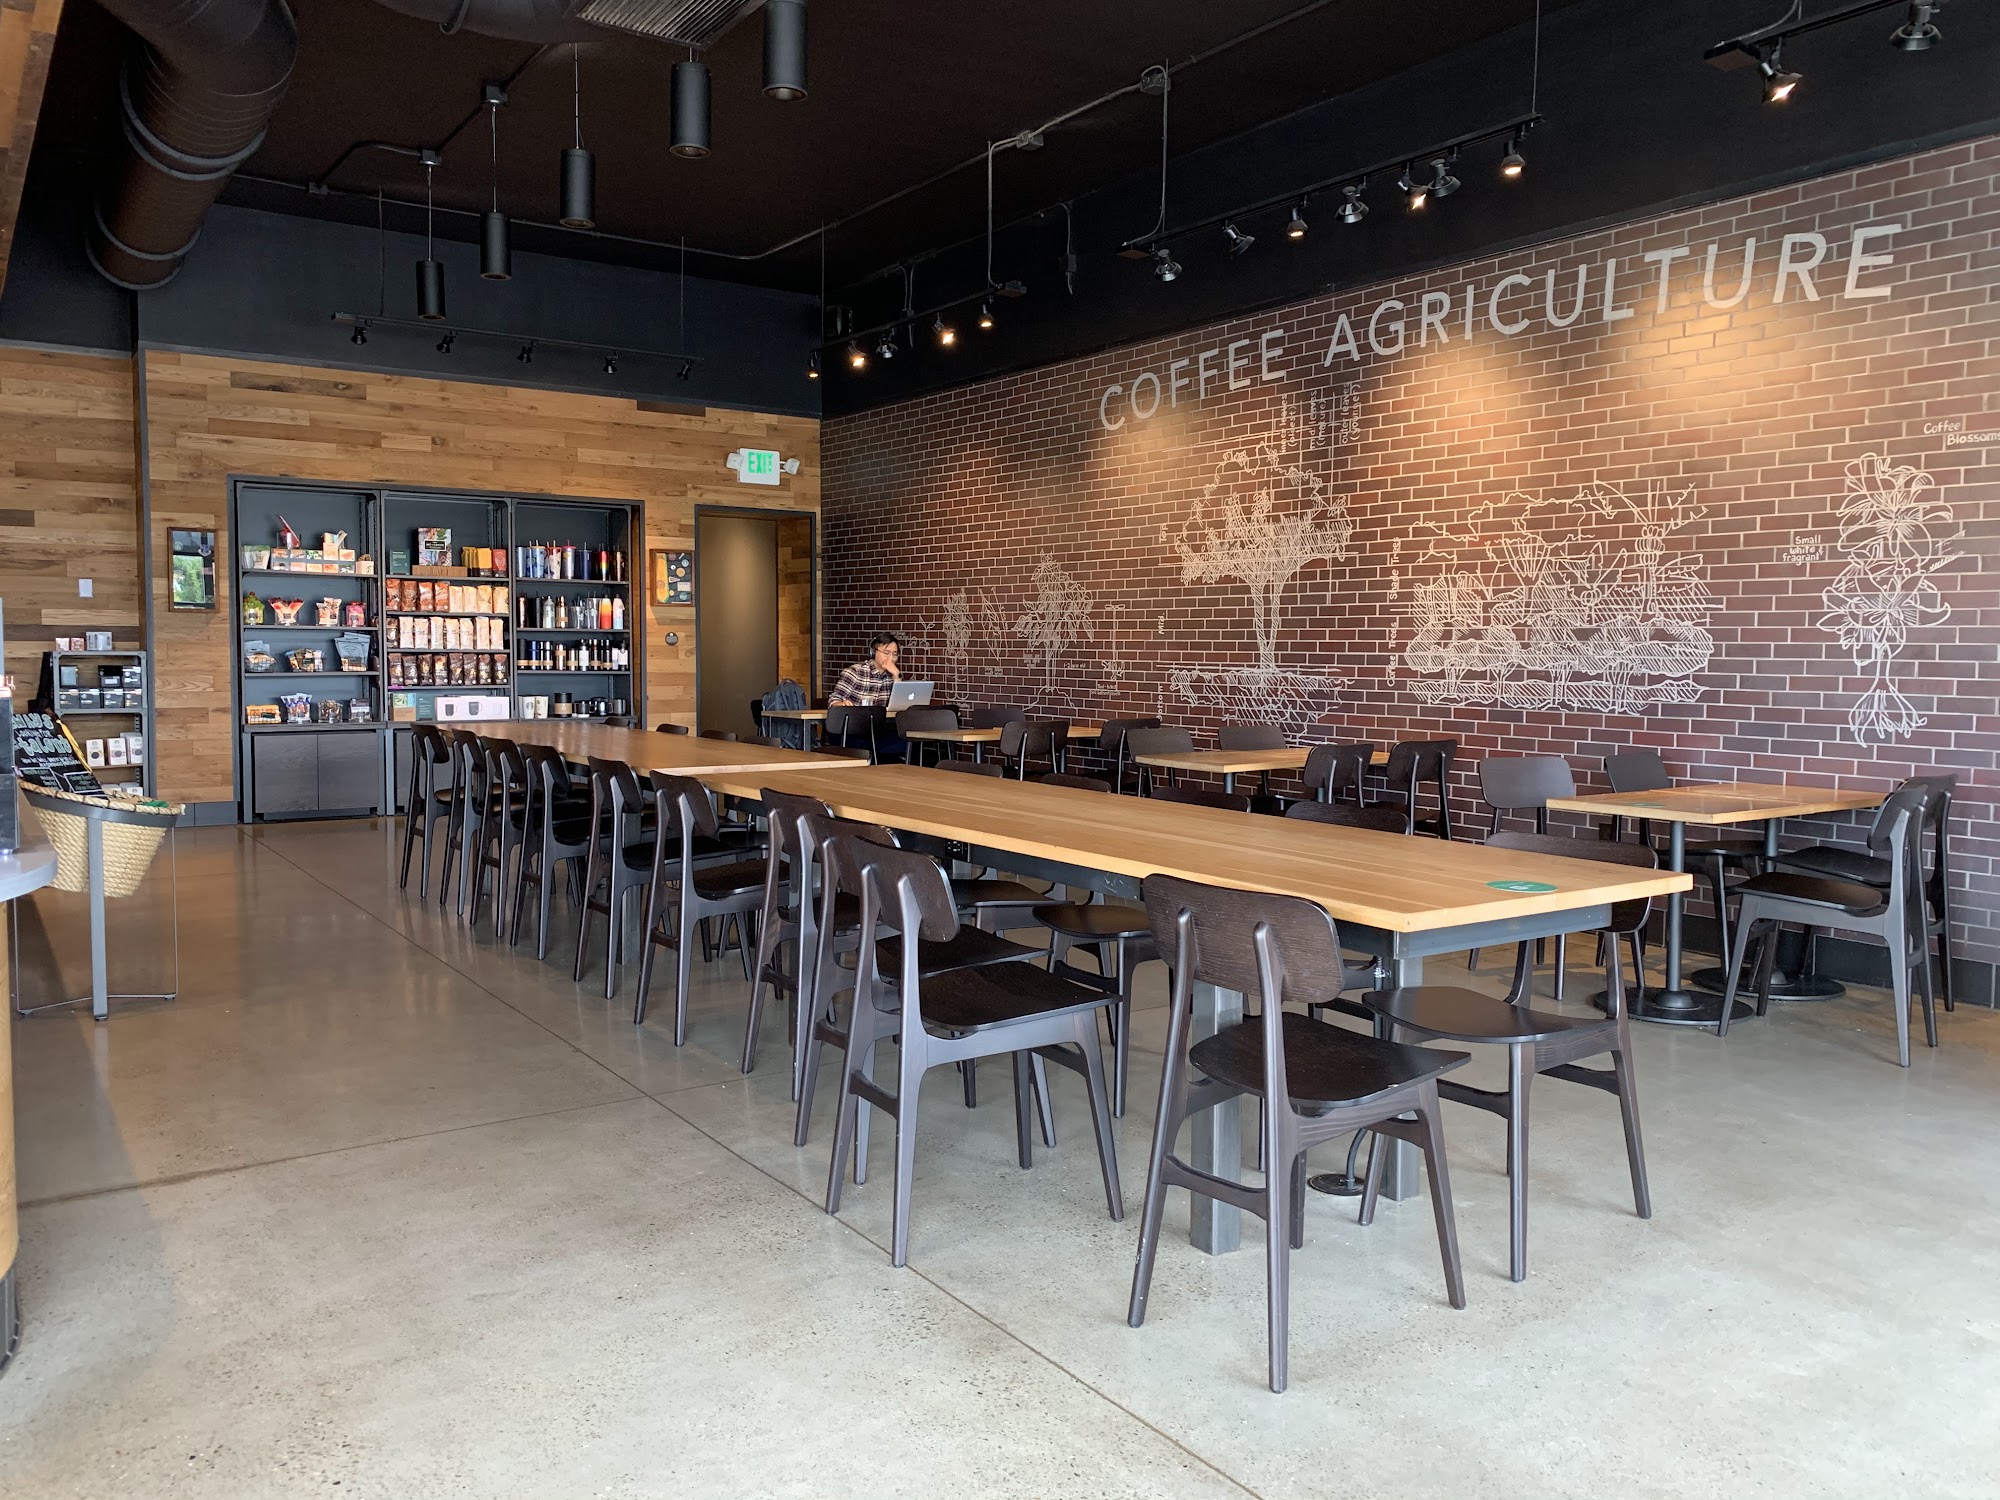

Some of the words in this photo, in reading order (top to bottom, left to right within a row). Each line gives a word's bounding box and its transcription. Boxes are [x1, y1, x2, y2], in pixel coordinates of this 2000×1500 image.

[1100, 328, 1286, 431] COFFEE
[1323, 223, 1902, 368] AGRICULTURE
[1279, 394, 1288, 426] leaves
[1308, 389, 1317, 424] leaves
[1340, 383, 1349, 416] leaves
[1350, 384, 1360, 440] (younger)
[1288, 406, 1296, 446] (oldest)
[1340, 417, 1349, 444] outer
[1923, 420, 1961, 434] Coffee
[1279, 428, 1287, 453] inner
[748, 451, 773, 474] EXIT
[1159, 523, 1168, 544] Top
[1795, 534, 1821, 545] Small
[1390, 536, 1400, 565] Trees
[1782, 551, 1820, 566] fragrant
[1790, 546, 1816, 555] white
[1389, 568, 1399, 600] Shade
[1388, 621, 1397, 649] Trees
[1387, 655, 1396, 687] Coffee
